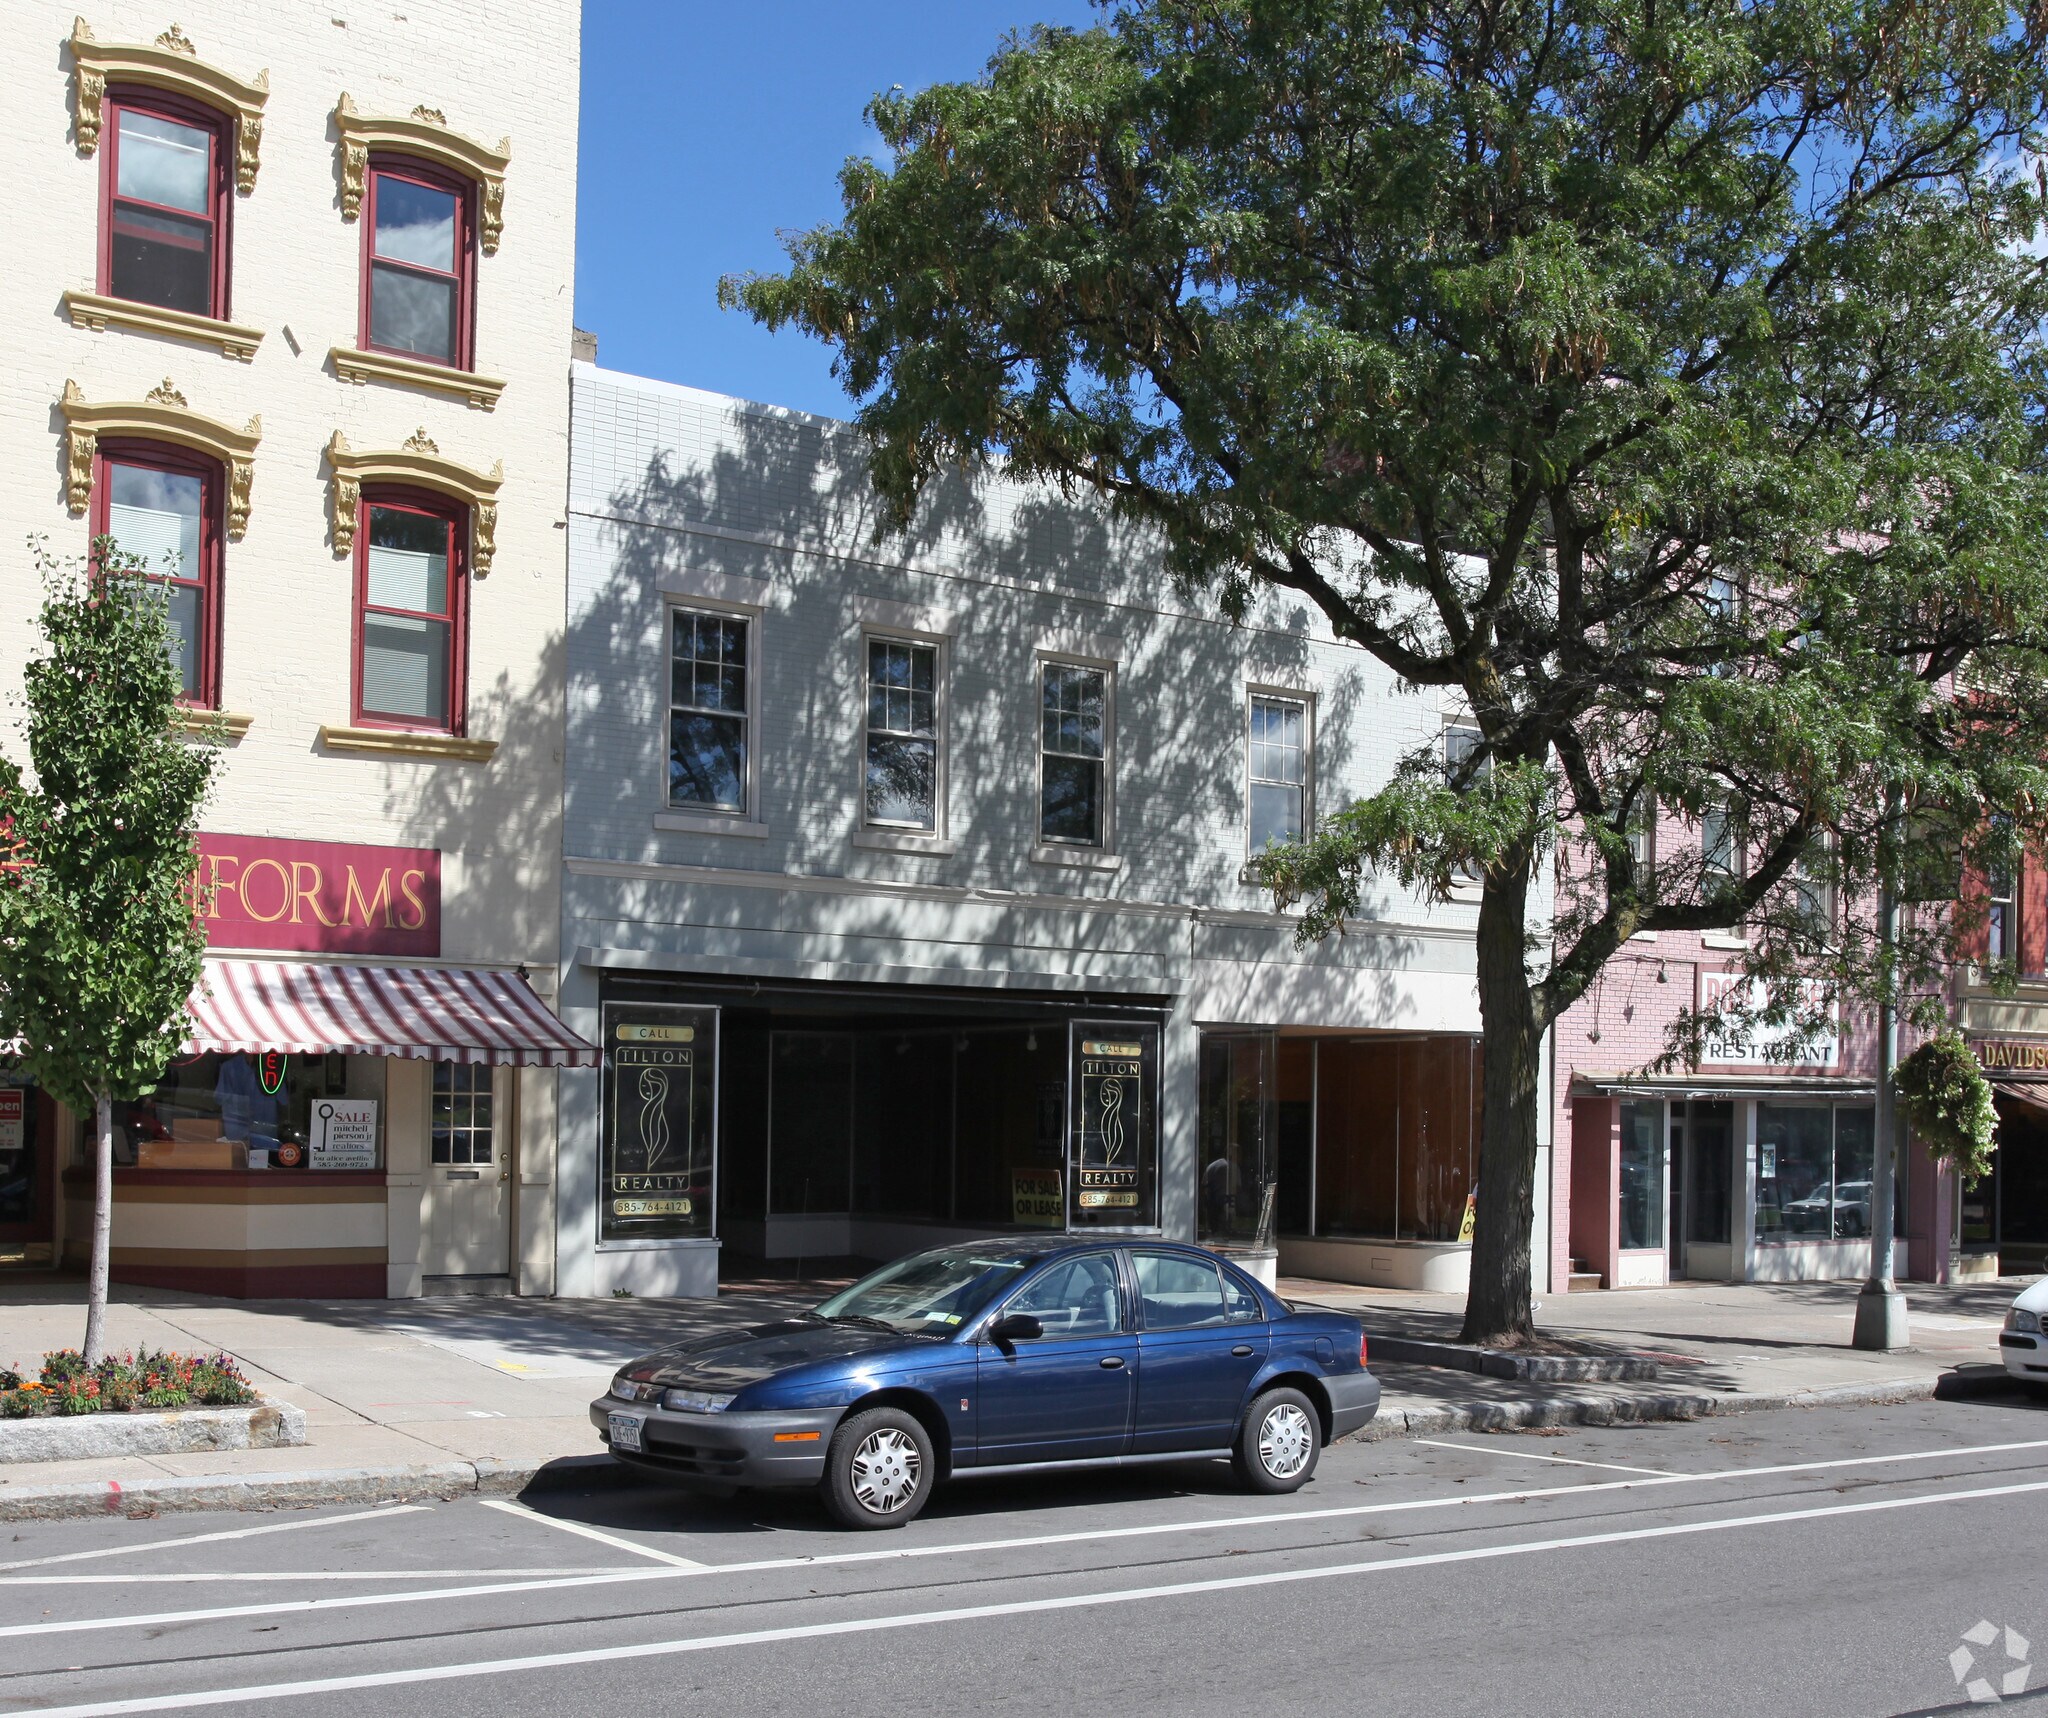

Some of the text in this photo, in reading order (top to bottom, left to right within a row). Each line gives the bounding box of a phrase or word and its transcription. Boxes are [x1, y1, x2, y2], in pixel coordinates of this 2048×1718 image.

[180, 854, 426, 930] IFORMS
[639, 1028, 670, 1039] CALL
[1100, 1043, 1123, 1053] CALL
[1709, 1043, 1832, 1061] RESTAURANT
[622, 1049, 689, 1063] TILTON
[1984, 1044, 2048, 1069] DAVIDS
[1087, 1062, 1138, 1075] TILTON
[334, 1112, 371, 1123] SALE
[333, 1124, 368, 1132] mitchell
[333, 1132, 365, 1141] pierson
[332, 1142, 365, 1150] realtors
[620, 1176, 685, 1189] REALTY
[1085, 1173, 1135, 1184] REALTY
[1015, 1179, 1060, 1196] FOR SALE
[1082, 1195, 1136, 1204] 585-764-4121
[617, 1201, 687, 1213] 585-764-4121
[1016, 1198, 1062, 1217] OR LEASE
